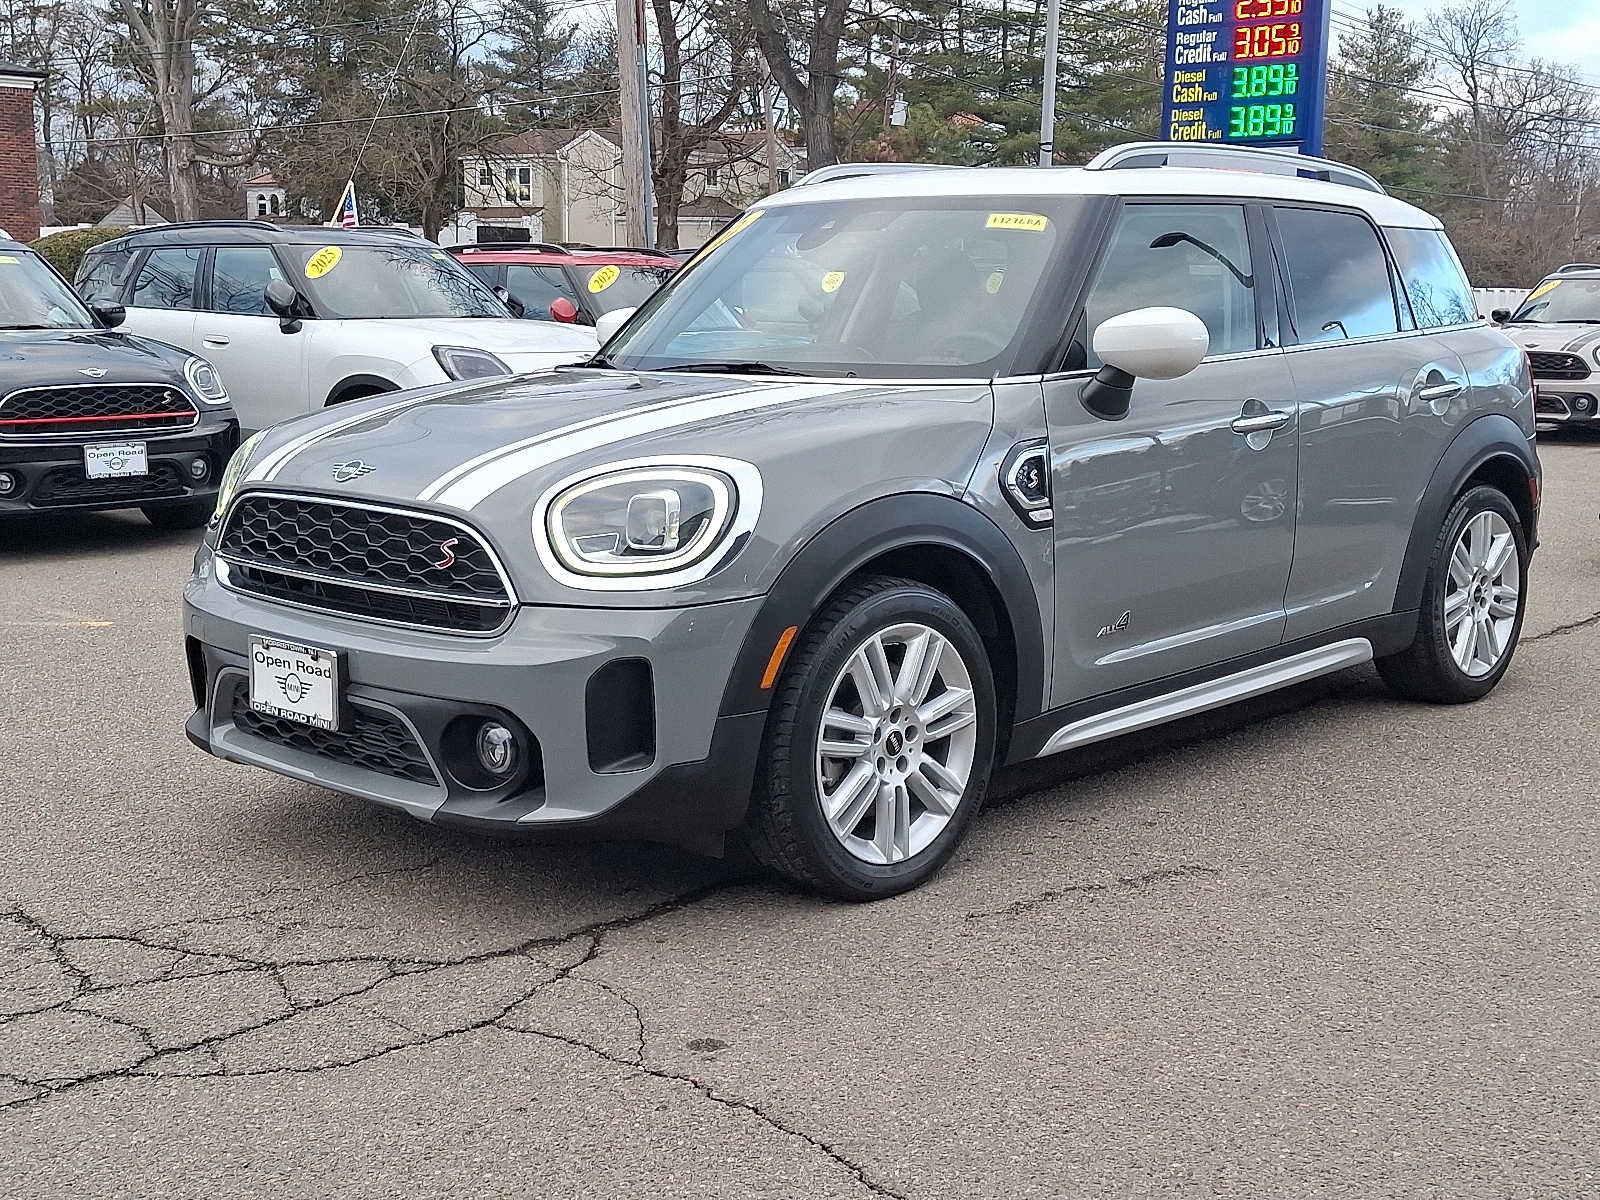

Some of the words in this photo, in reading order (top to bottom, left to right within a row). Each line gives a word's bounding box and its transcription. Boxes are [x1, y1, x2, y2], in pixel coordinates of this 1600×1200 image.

[1178, 5, 1207, 25] Cash
[1208, 13, 1222, 22] Full
[1176, 29, 1217, 46] Regular
[1235, 25, 1286, 58] 3.05
[1175, 43, 1212, 64] Credit
[1212, 52, 1227, 62] Full
[1174, 69, 1206, 83] Diesel
[1232, 65, 1284, 98] 3.89
[1173, 83, 1203, 103] Cash
[1203, 91, 1217, 101] Full
[1171, 108, 1204, 122] Diesel
[1229, 104, 1282, 137] 3.89
[1170, 121, 1207, 141] Credit
[1207, 129, 1222, 140] Full
[88, 452, 115, 460] Open
[1028, 468, 1039, 488] S
[434, 537, 458, 569] S
[254, 651, 291, 670] Open
[296, 659, 332, 679] Road
[254, 702, 279, 716] OPEN
[280, 709, 307, 724] ROAD
[309, 716, 331, 729] MINI
